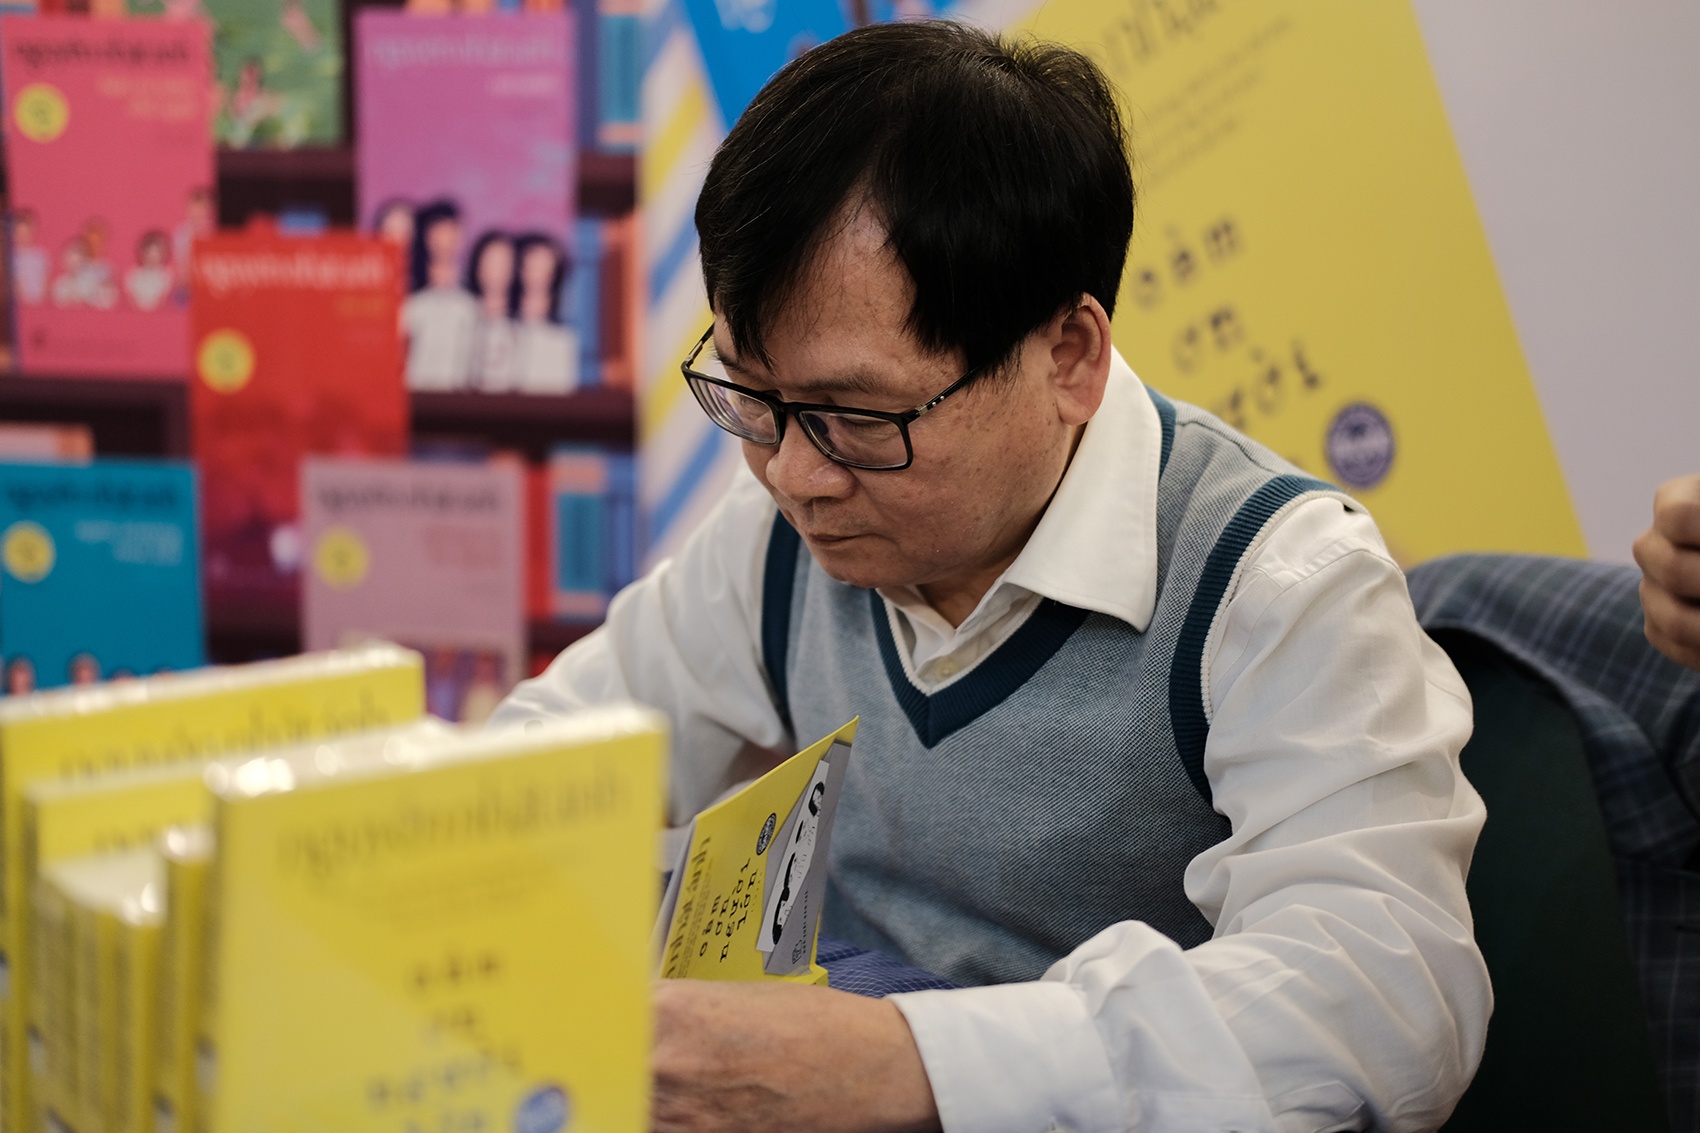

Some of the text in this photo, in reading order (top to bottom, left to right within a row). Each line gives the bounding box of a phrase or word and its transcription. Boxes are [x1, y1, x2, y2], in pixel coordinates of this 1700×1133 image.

[714, 897, 731, 936] ơn
[719, 857, 751, 963] người
[736, 869, 758, 931] lớn
